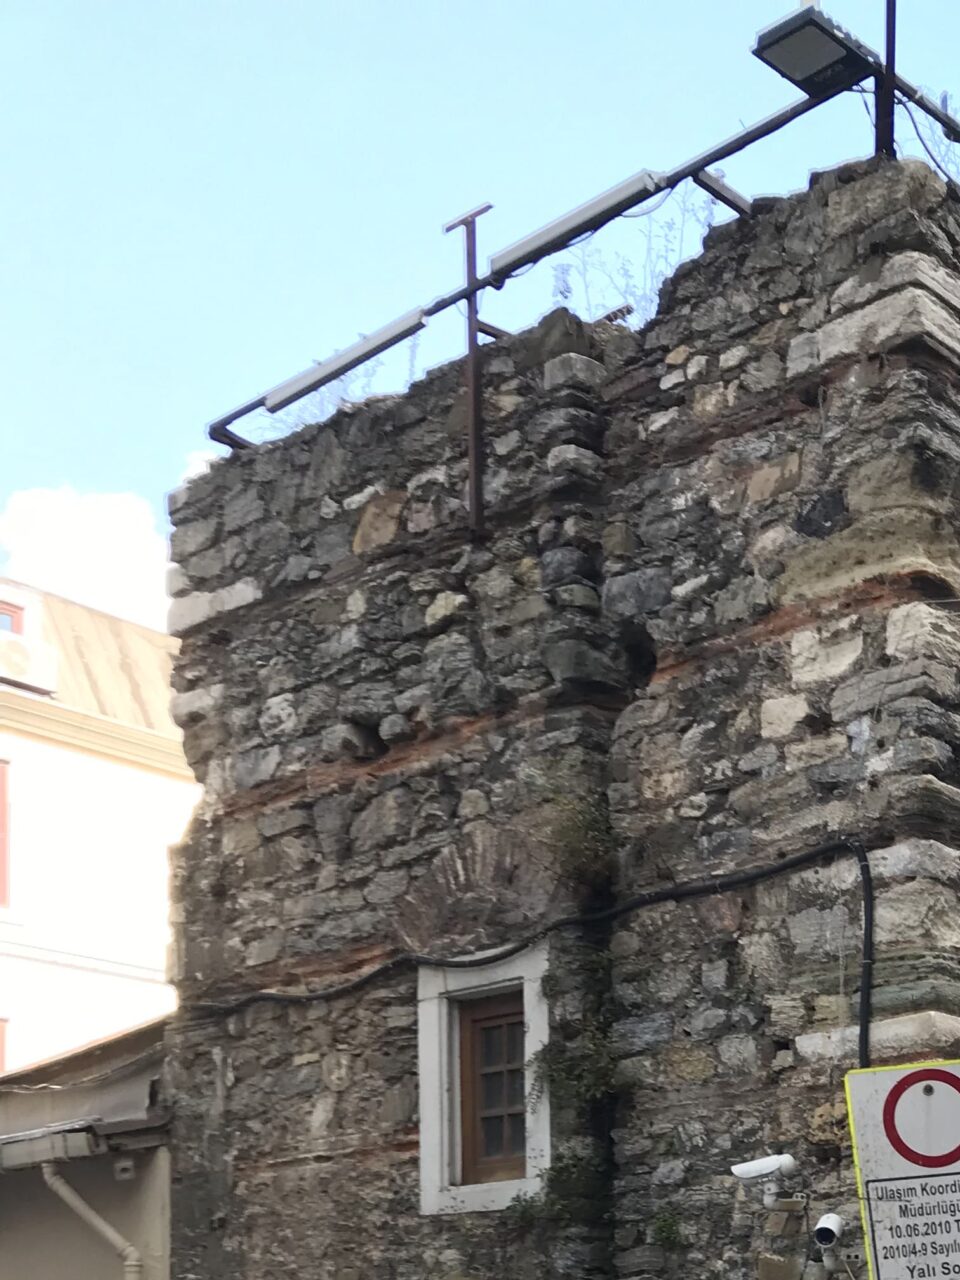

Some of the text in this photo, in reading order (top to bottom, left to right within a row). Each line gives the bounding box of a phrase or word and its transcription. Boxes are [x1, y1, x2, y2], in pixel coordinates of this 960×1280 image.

[875, 1187, 917, 1201] Ulaşım
[888, 1220, 951, 1239] 10.06.2010
[930, 1239, 960, 1257] Sayılı
[906, 1264, 937, 1279] Yalı
